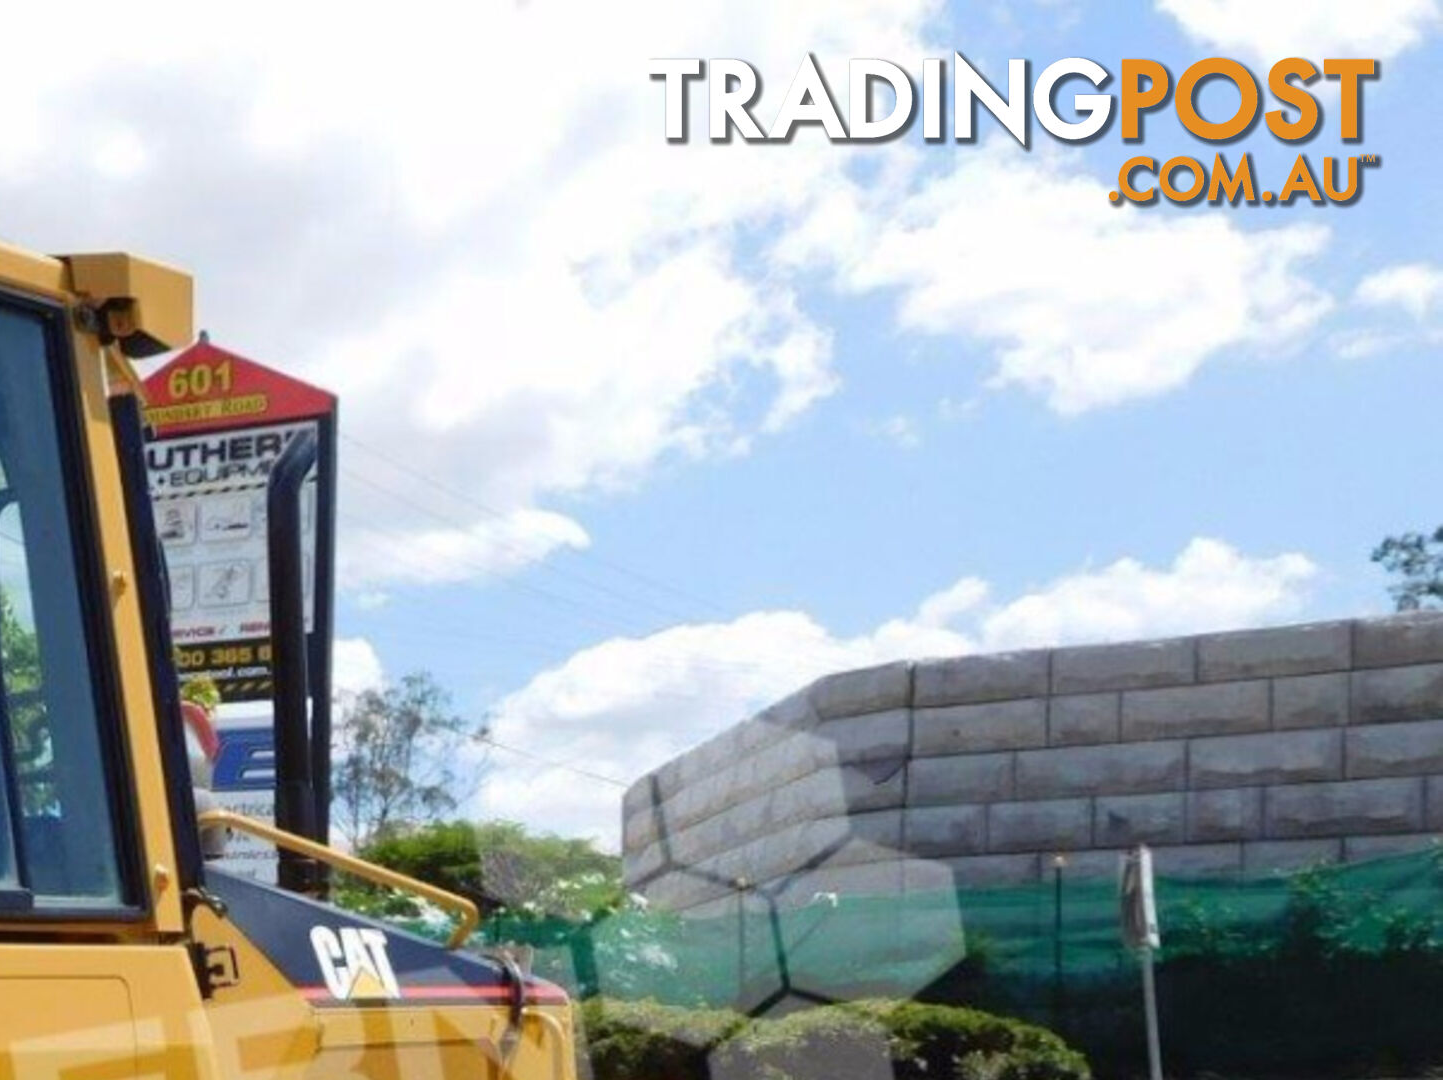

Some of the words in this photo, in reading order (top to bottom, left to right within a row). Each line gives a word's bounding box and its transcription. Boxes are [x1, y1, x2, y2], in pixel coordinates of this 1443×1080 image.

[169, 360, 233, 398] 601
[148, 430, 294, 471] UTHER
[309, 925, 401, 999] CAT
